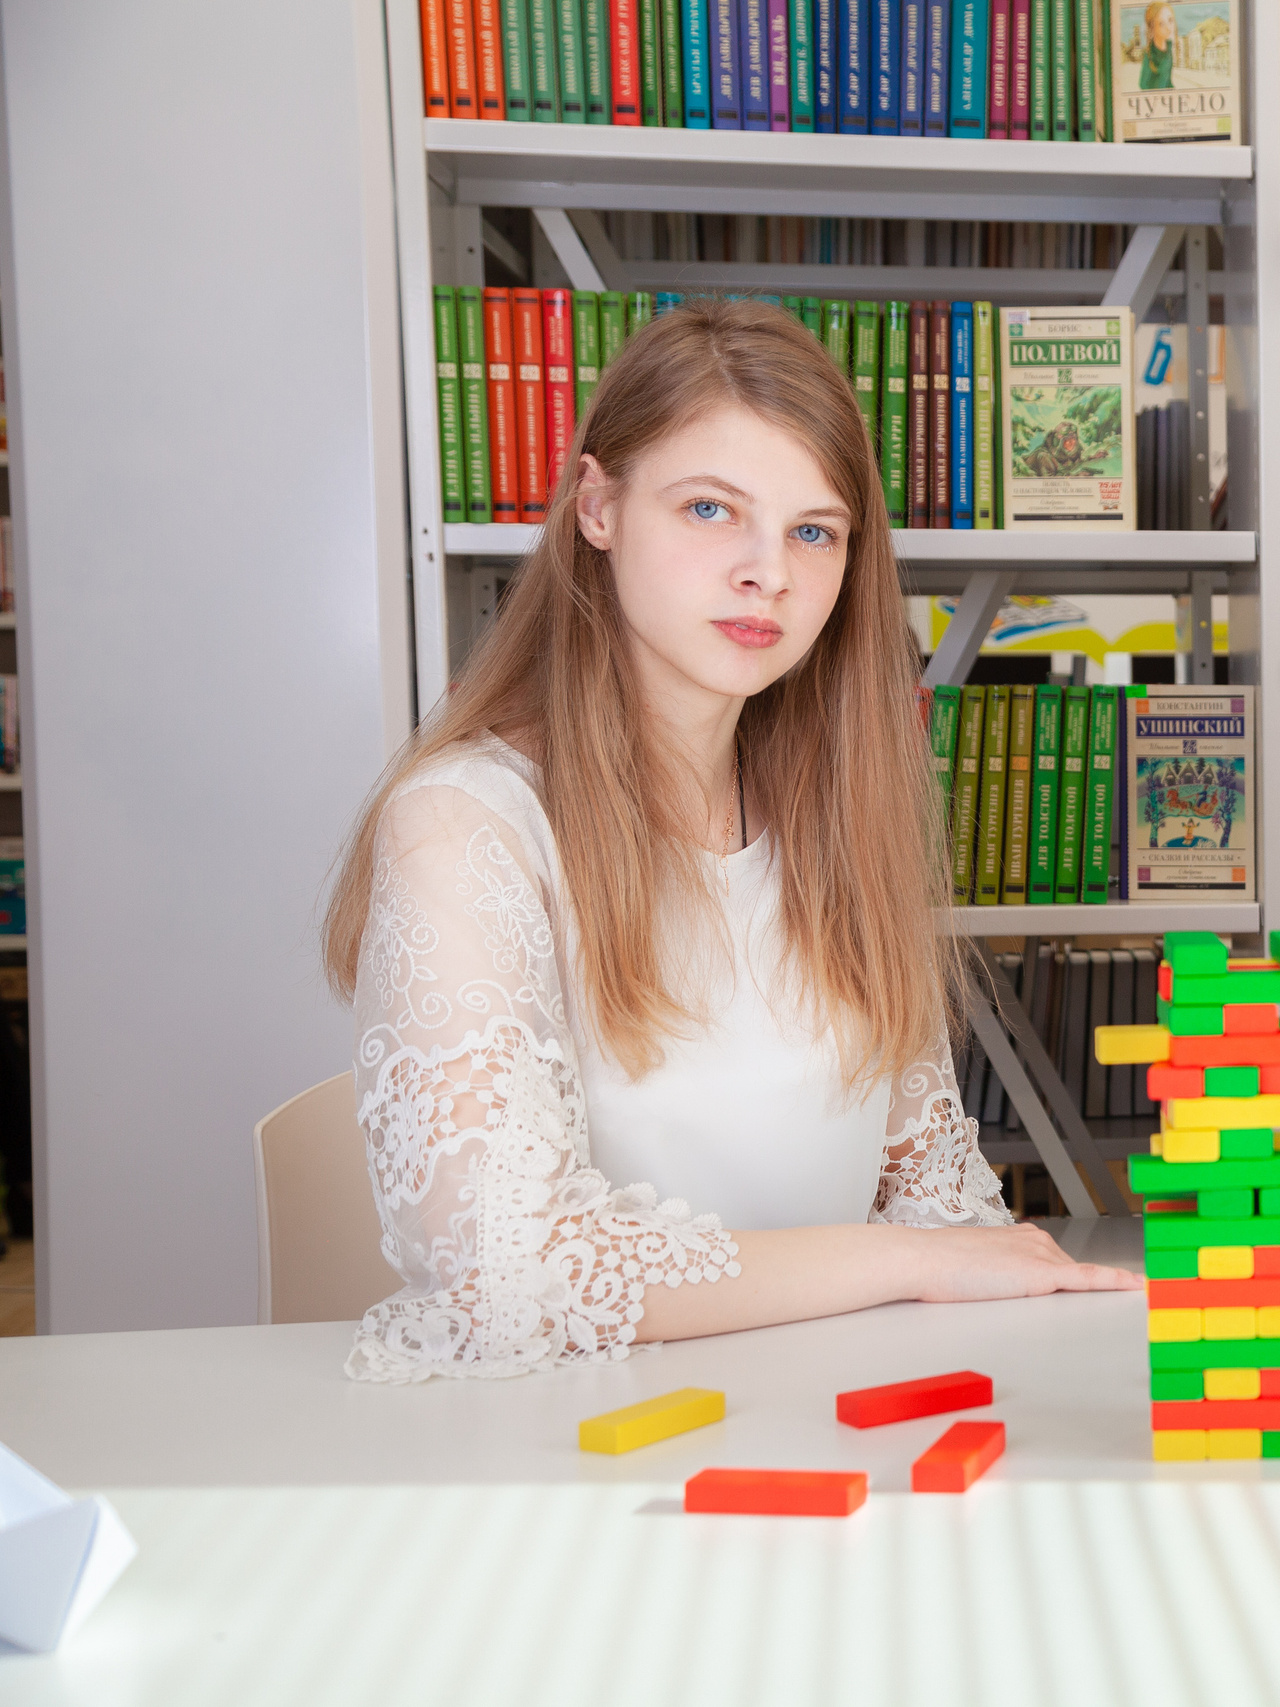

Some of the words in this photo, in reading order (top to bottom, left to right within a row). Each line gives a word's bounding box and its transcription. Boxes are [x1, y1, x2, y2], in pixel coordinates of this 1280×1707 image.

[1128, 92, 1225, 117] ЧУЧЕЛО
[1048, 324, 1079, 333] БОРИС
[1013, 340, 1118, 362] ПОЛЕВОЙ
[891, 415, 902, 462] ЛАРРИ
[916, 394, 924, 455] ЛЕРМОНТОВ
[938, 394, 946, 455] ЛЕРМОНТОВ
[980, 400, 989, 452] ОЛЕША
[445, 450, 458, 496] ЕЛЕНА
[471, 450, 483, 496] ЕЛЕНА
[891, 469, 901, 489] ЯН
[916, 459, 924, 503] МИХАИЛ
[937, 459, 946, 503] МИХАИЛ
[978, 460, 989, 501] ЮРИЙ
[1140, 717, 1242, 735] УШИНСКИЙ
[1157, 702, 1223, 710] КОНСТАНТИН
[960, 785, 972, 839] ТУРГЕНЕВ
[987, 784, 998, 838] ТУРГЕНЕВ
[1012, 779, 1024, 838] ТУРГЕНЕВ
[1038, 784, 1050, 841] ТОЛСТОЙ
[1063, 786, 1077, 842] ТОЛСТОЙ
[1093, 784, 1105, 840] ТОЛСТОЙ
[957, 844, 967, 874] ИВАН
[986, 843, 995, 873] ИВАН
[1011, 844, 1021, 878] ИВАН
[1038, 846, 1048, 870] ЛЕВ
[1063, 848, 1073, 871] ЛЕВ
[1092, 846, 1102, 869] ЛЕВ
